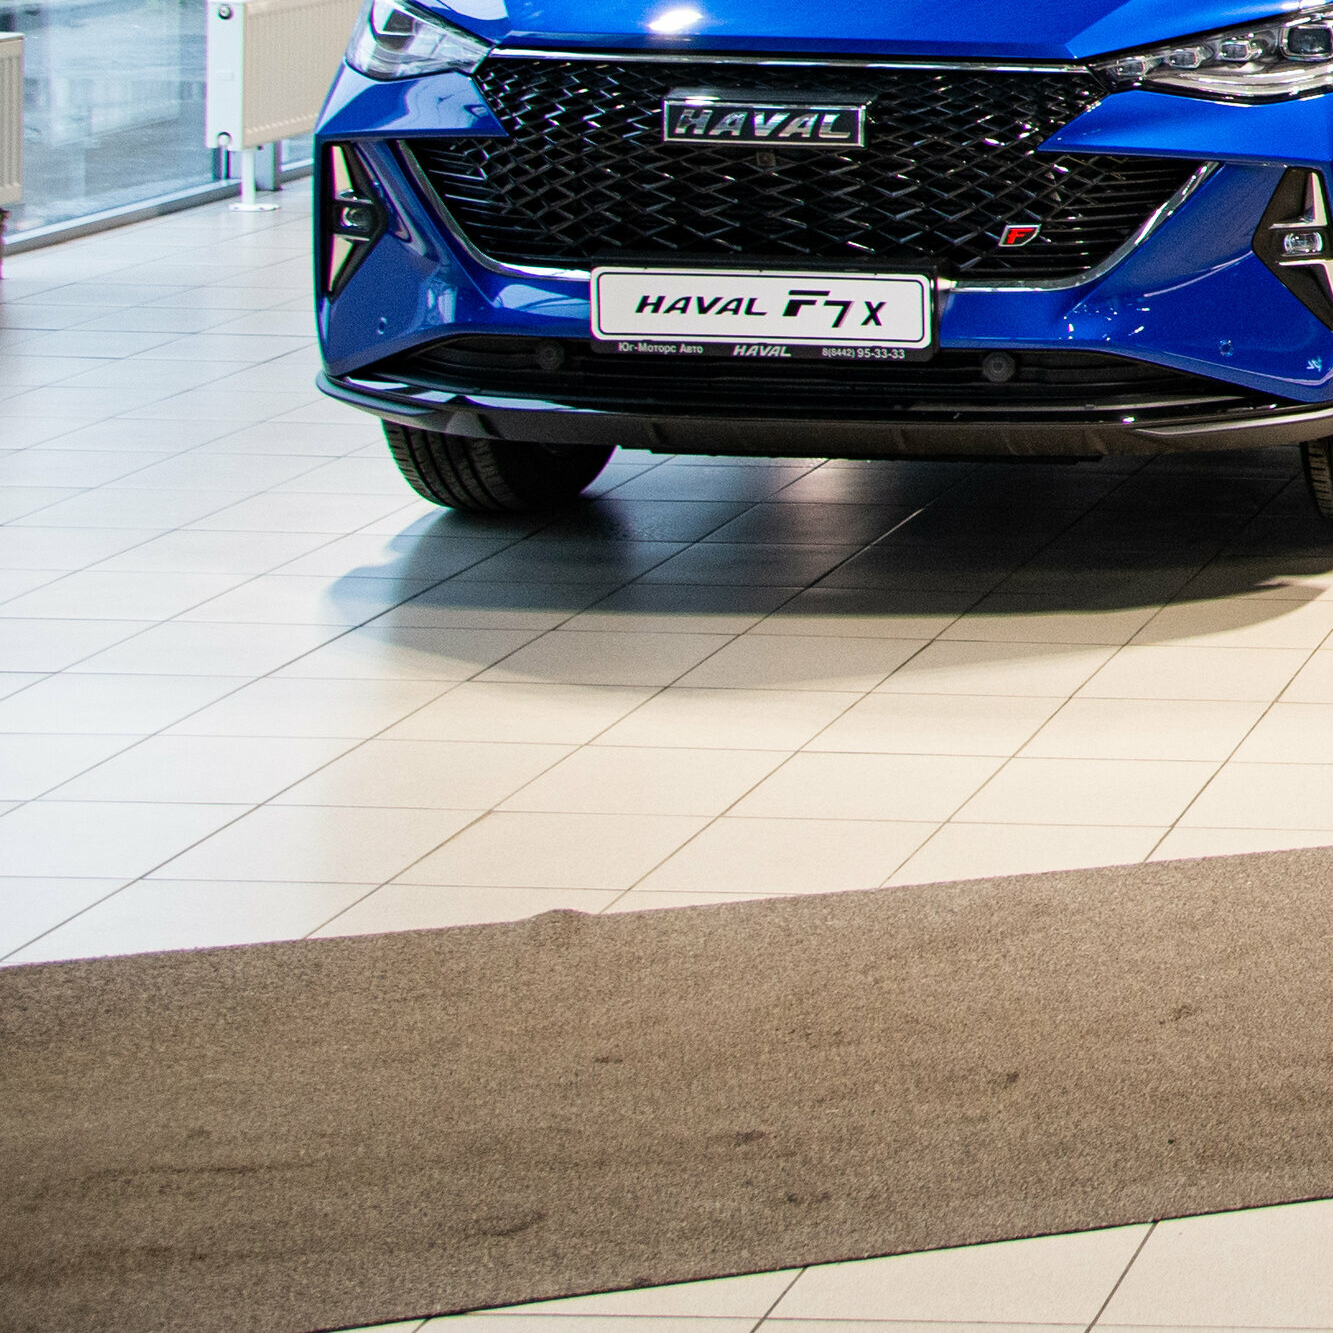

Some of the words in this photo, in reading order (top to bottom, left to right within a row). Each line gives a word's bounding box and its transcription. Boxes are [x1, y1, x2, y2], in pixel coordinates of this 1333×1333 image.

[674, 109, 852, 139] HAVAL
[1005, 228, 1036, 245] F
[635, 295, 767, 316] HAVAL
[618, 342, 676, 355] Юг-Моторс
[680, 343, 704, 354] Авто
[732, 345, 792, 357] HAVAL
[857, 348, 905, 359] 95-33-33
